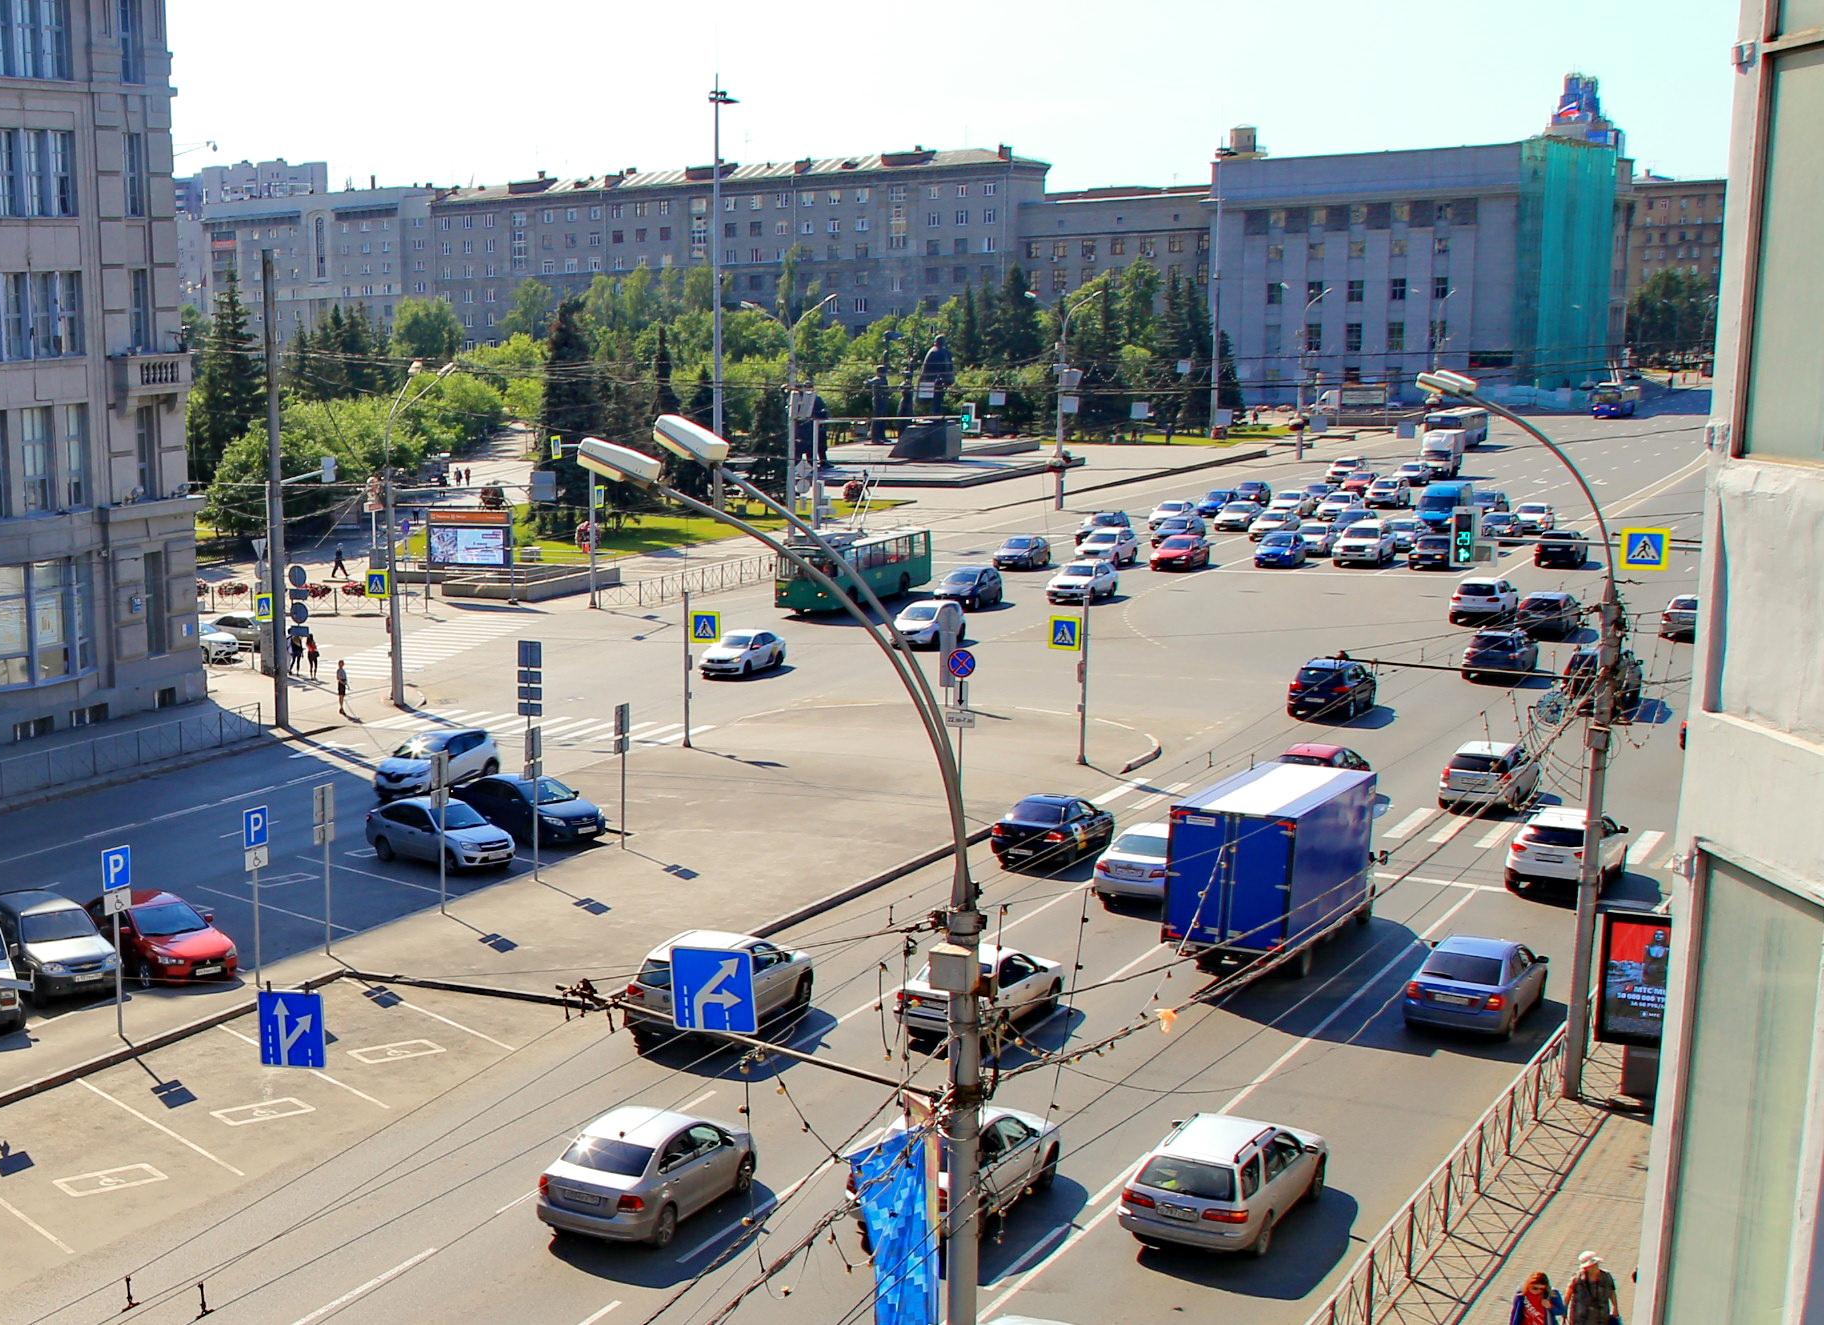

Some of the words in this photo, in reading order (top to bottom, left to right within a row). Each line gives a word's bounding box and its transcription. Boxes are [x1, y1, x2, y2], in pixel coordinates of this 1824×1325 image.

[1457, 532, 1471, 545] 29
[250, 813, 263, 843] P
[109, 854, 124, 884] P
